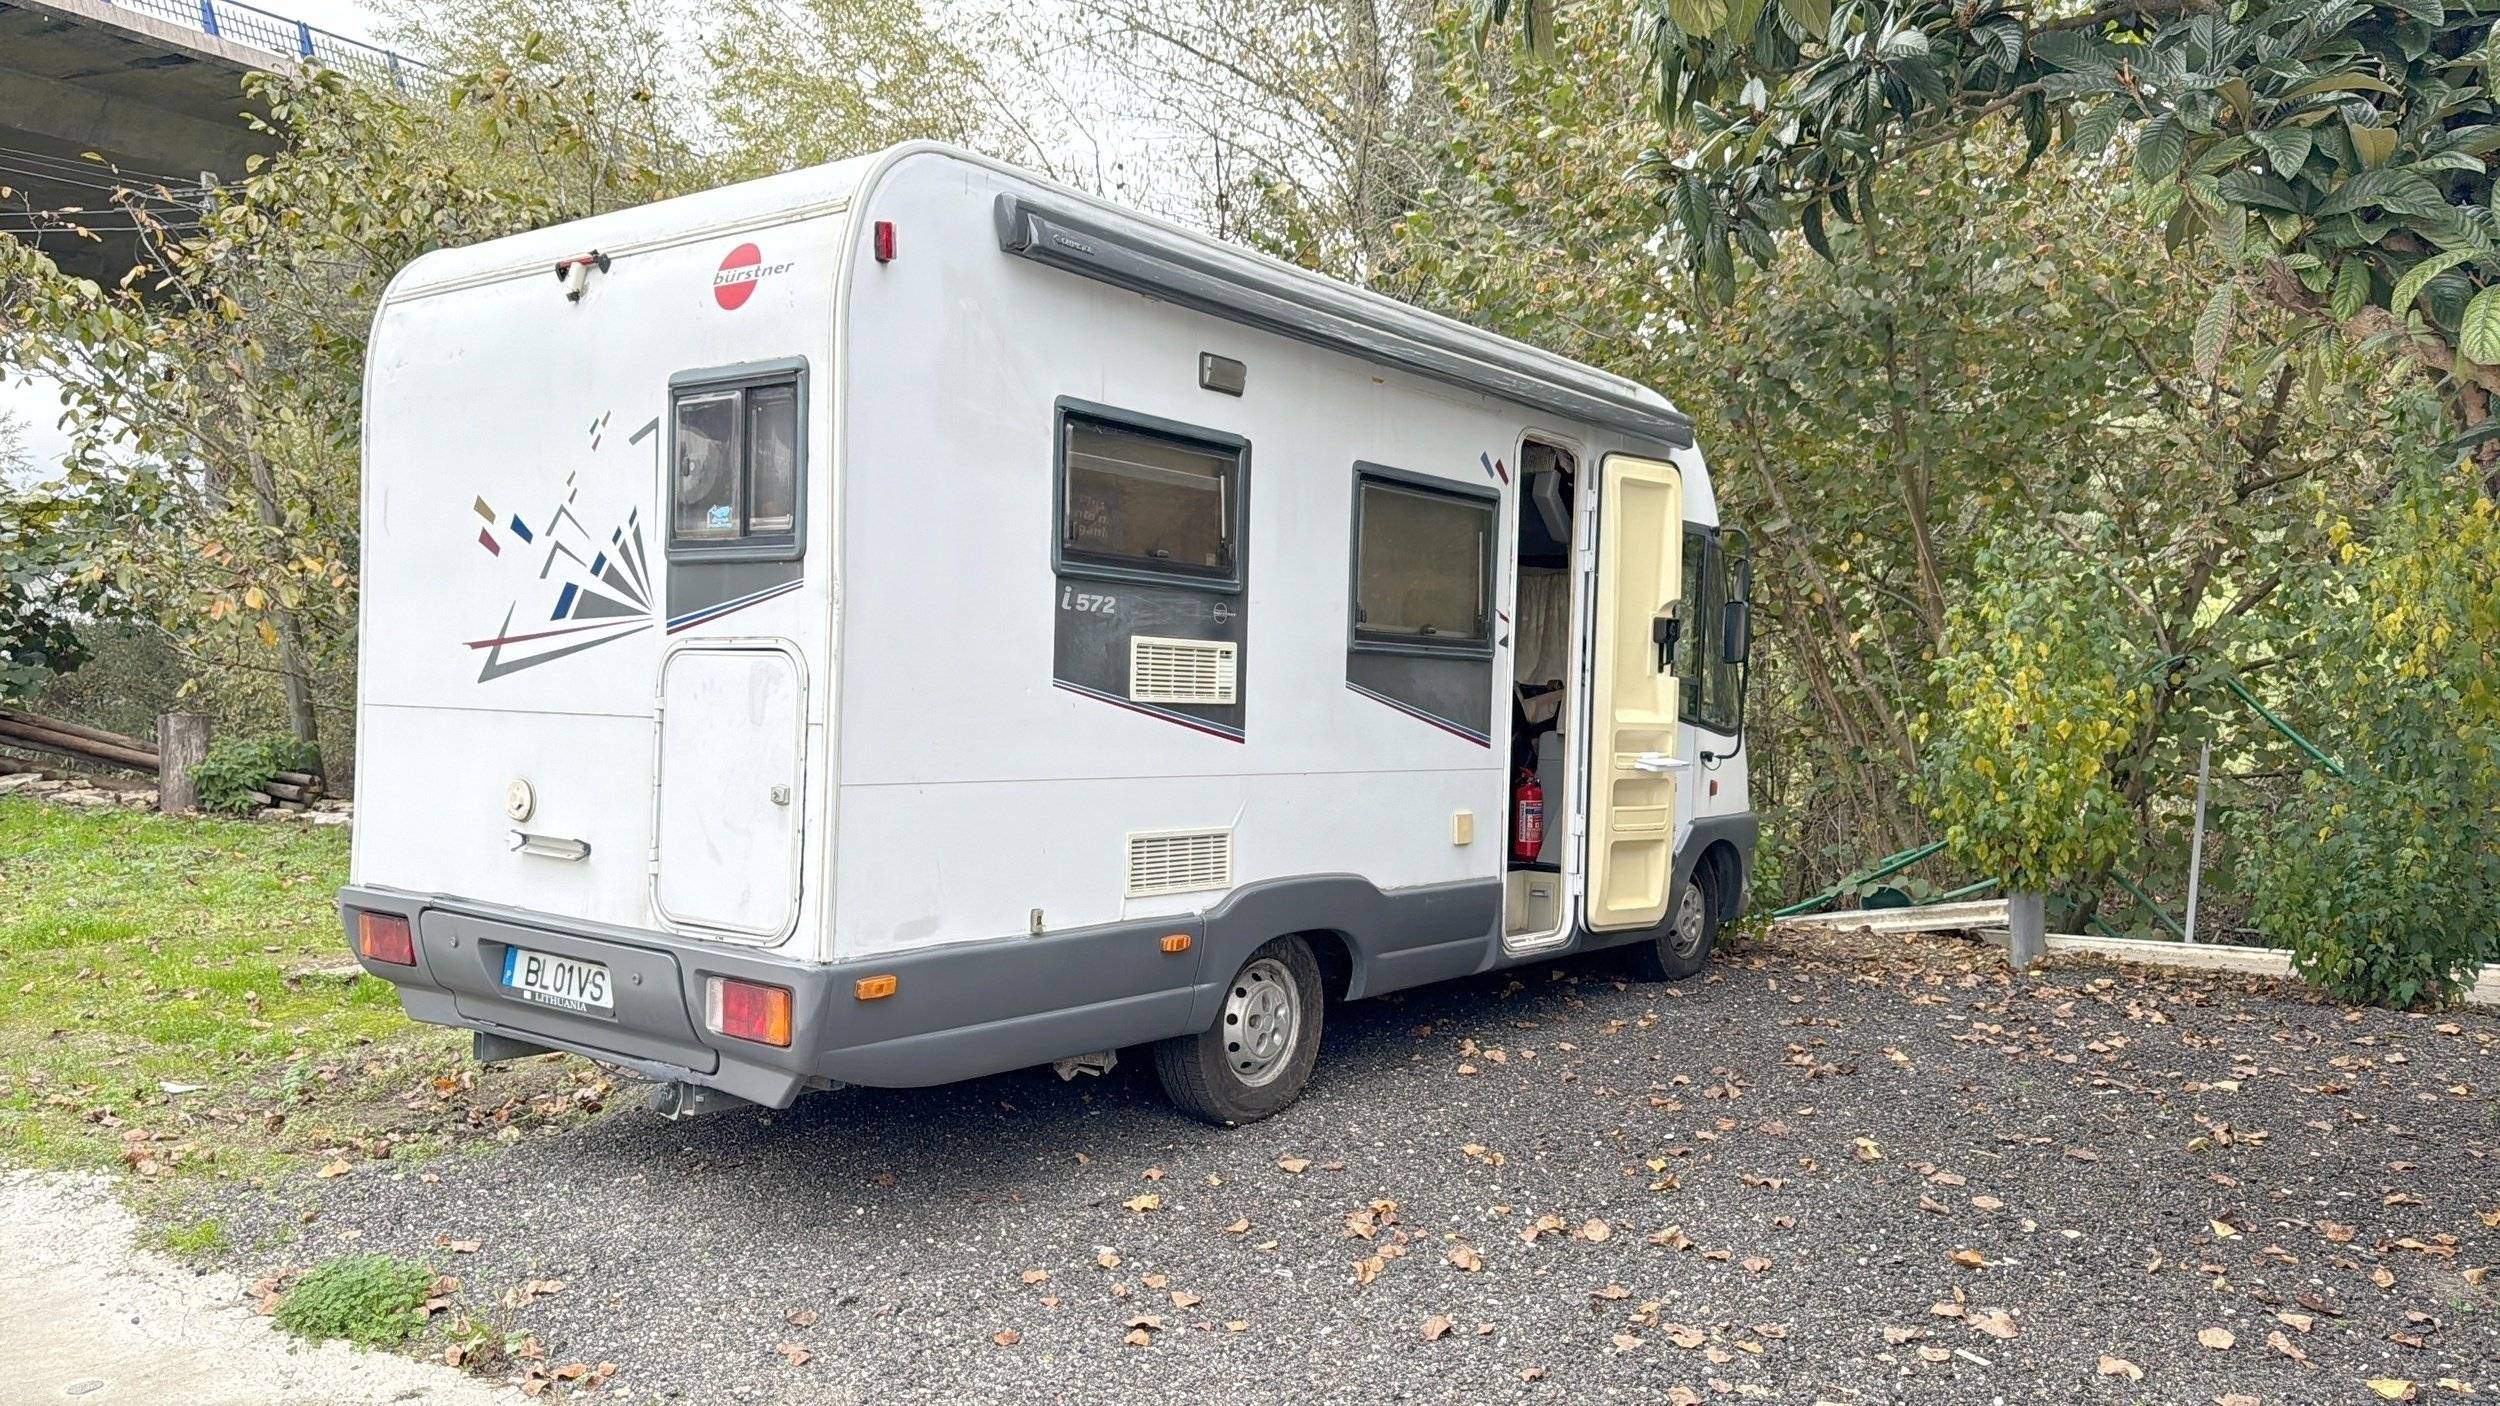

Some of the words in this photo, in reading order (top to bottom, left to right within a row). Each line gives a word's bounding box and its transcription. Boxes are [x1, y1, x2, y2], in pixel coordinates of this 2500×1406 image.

[713, 262, 795, 286] bürstner
[1061, 585, 1072, 610] i
[1075, 593, 1116, 614] 572
[535, 992, 587, 1012] LITHUANIA
